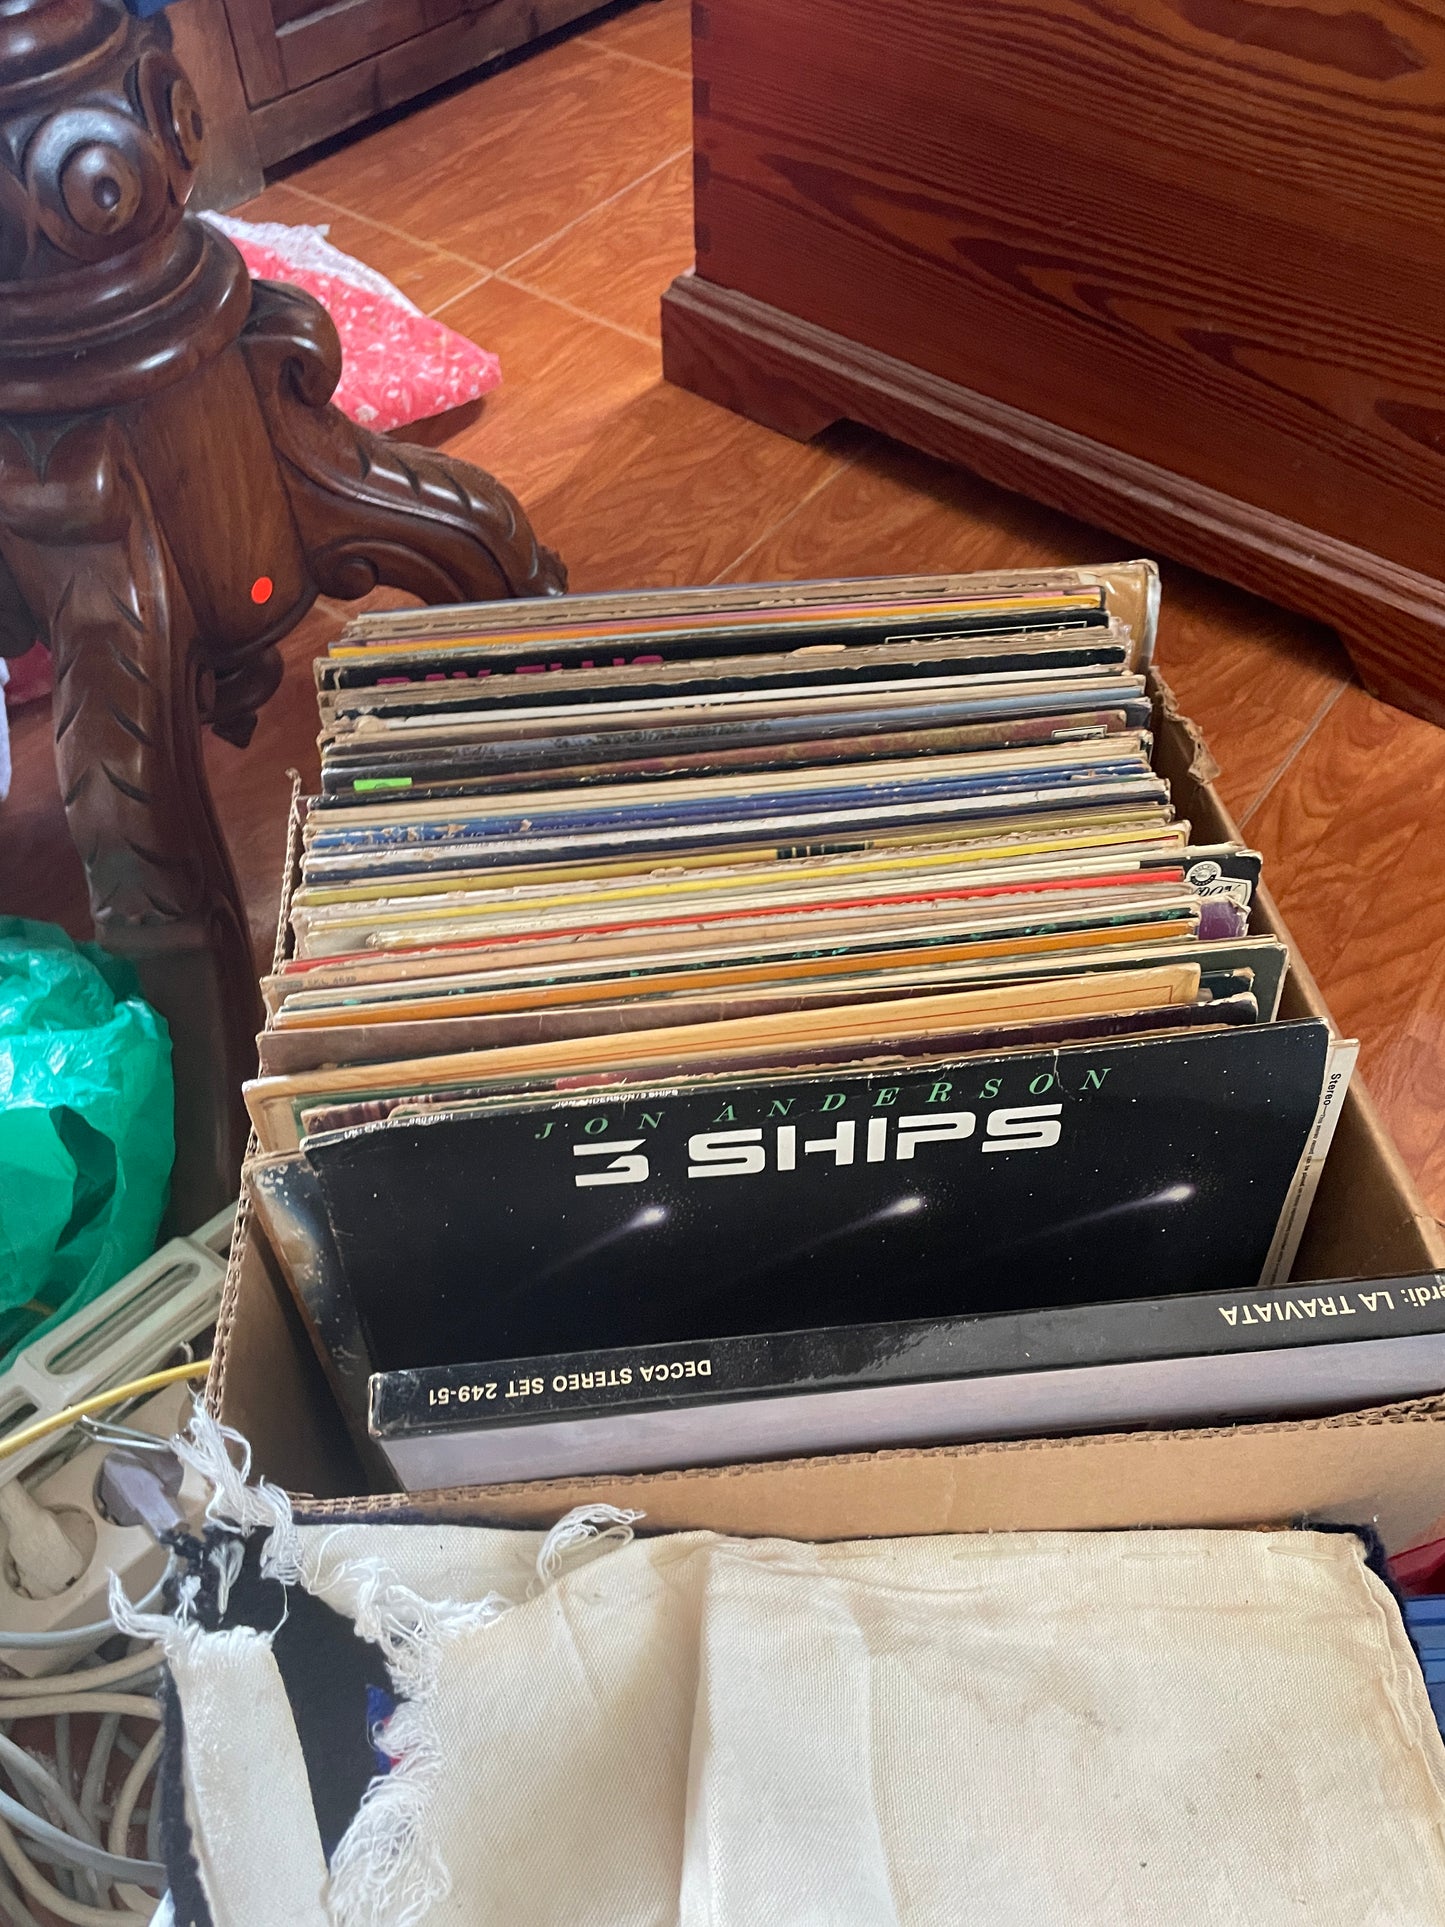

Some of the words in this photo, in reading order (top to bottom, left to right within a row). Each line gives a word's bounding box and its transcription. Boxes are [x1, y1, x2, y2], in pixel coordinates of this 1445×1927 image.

[535, 1112, 665, 1140] JON
[712, 1068, 1112, 1123] ANDERSON
[573, 1138, 650, 1187] 3
[687, 1103, 1063, 1179] SHIPS
[1358, 1291, 1395, 1312] LA
[1400, 1285, 1445, 1307] erdi:
[1218, 1295, 1356, 1326] TRAVIATA
[552, 1368, 633, 1393] STEREO
[639, 1359, 712, 1382] DECCA
[428, 1382, 498, 1406] 249-51
[505, 1377, 544, 1398] SET
